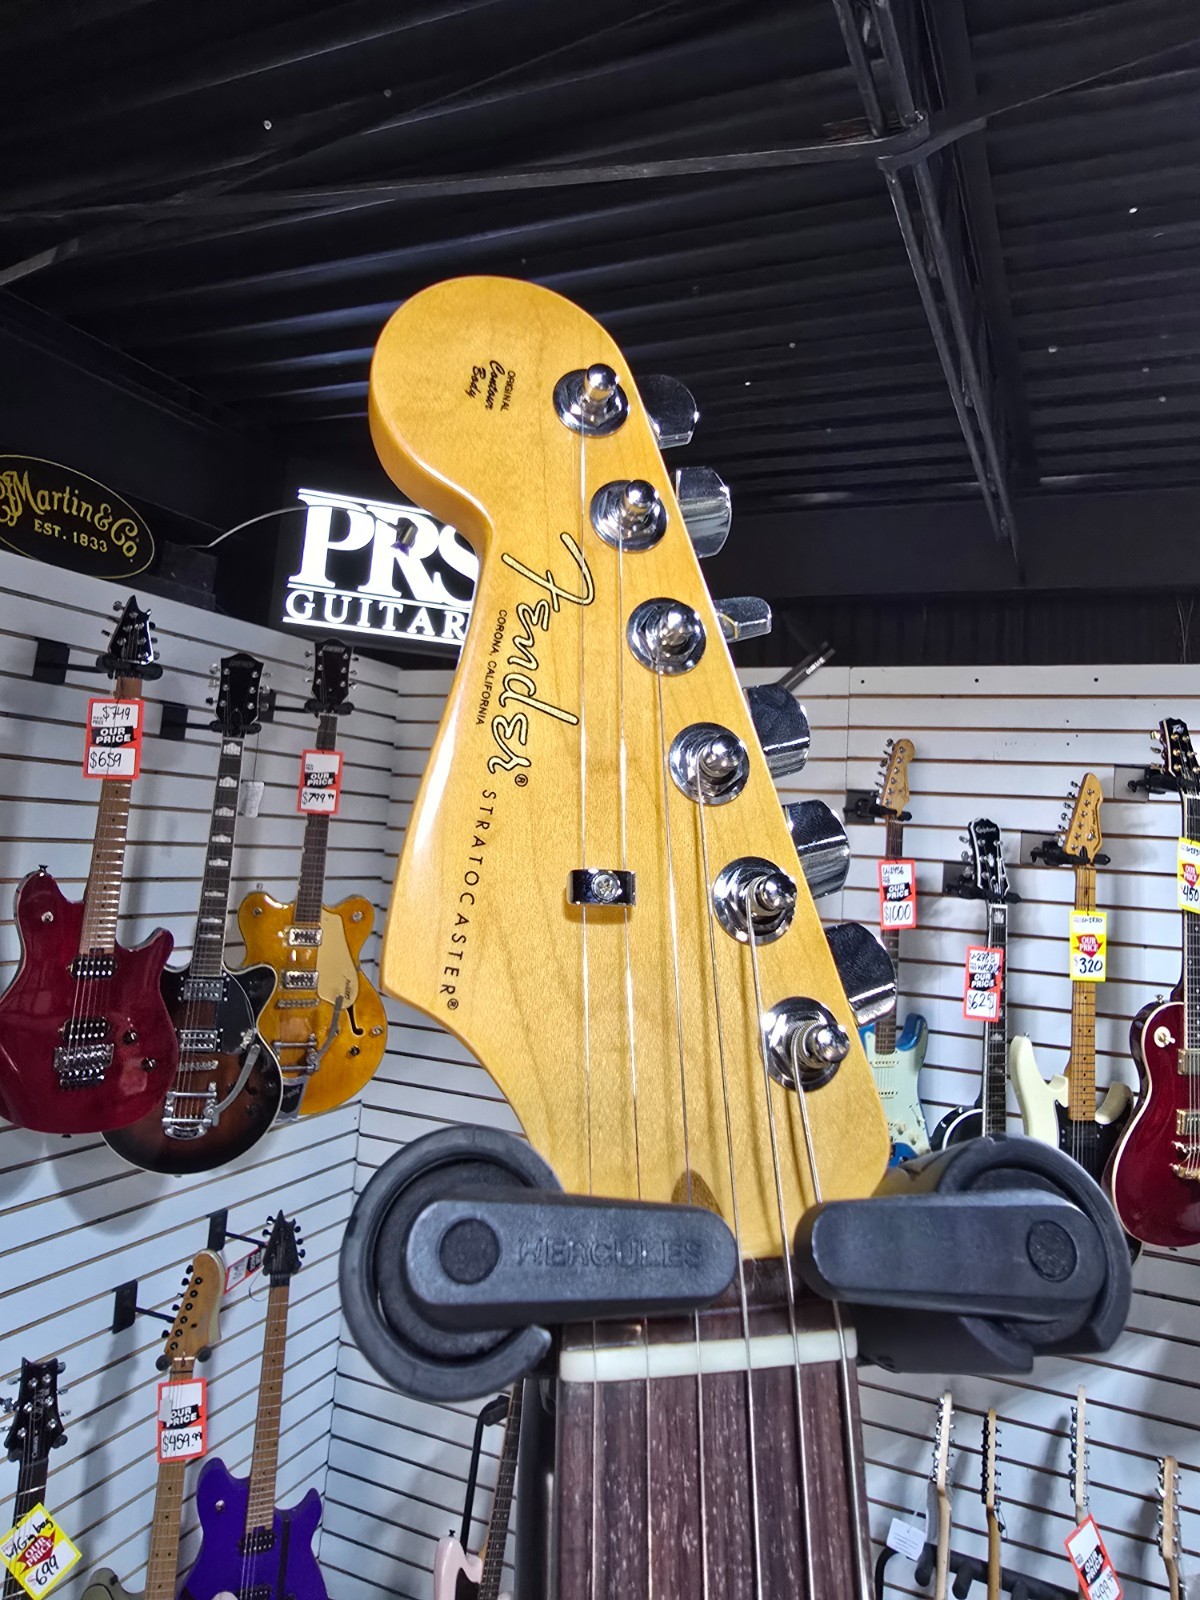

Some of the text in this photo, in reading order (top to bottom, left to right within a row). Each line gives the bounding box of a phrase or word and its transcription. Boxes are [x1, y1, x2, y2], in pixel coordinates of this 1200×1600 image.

[464, 366, 486, 399] Body
[500, 371, 516, 411] ORIGINAL
[73, 532, 108, 553] 1833
[288, 491, 479, 606] PRS
[475, 609, 507, 726] CORONA, CALIFORNIA
[102, 704, 131, 721] $749
[96, 734, 132, 744] PRICE
[100, 727, 126, 736] OUR
[90, 751, 122, 769] $659
[307, 778, 334, 786] PRICE
[310, 772, 330, 780] OUR
[886, 889, 909, 900] PRICE
[888, 884, 905, 892] OUR
[1079, 943, 1099, 952] PRICE
[1081, 936, 1096, 945] OUR
[971, 979, 994, 988] PRICE
[974, 973, 991, 981] OUR
[518, 1236, 702, 1268] HERCULES
[166, 1412, 198, 1428] PRICE
[171, 1406, 192, 1419] OUR
[25, 1537, 47, 1558] OUR
[26, 1538, 54, 1567] PRICE
[1084, 1550, 1098, 1573] OUR
[1086, 1553, 1104, 1584] PRICE
